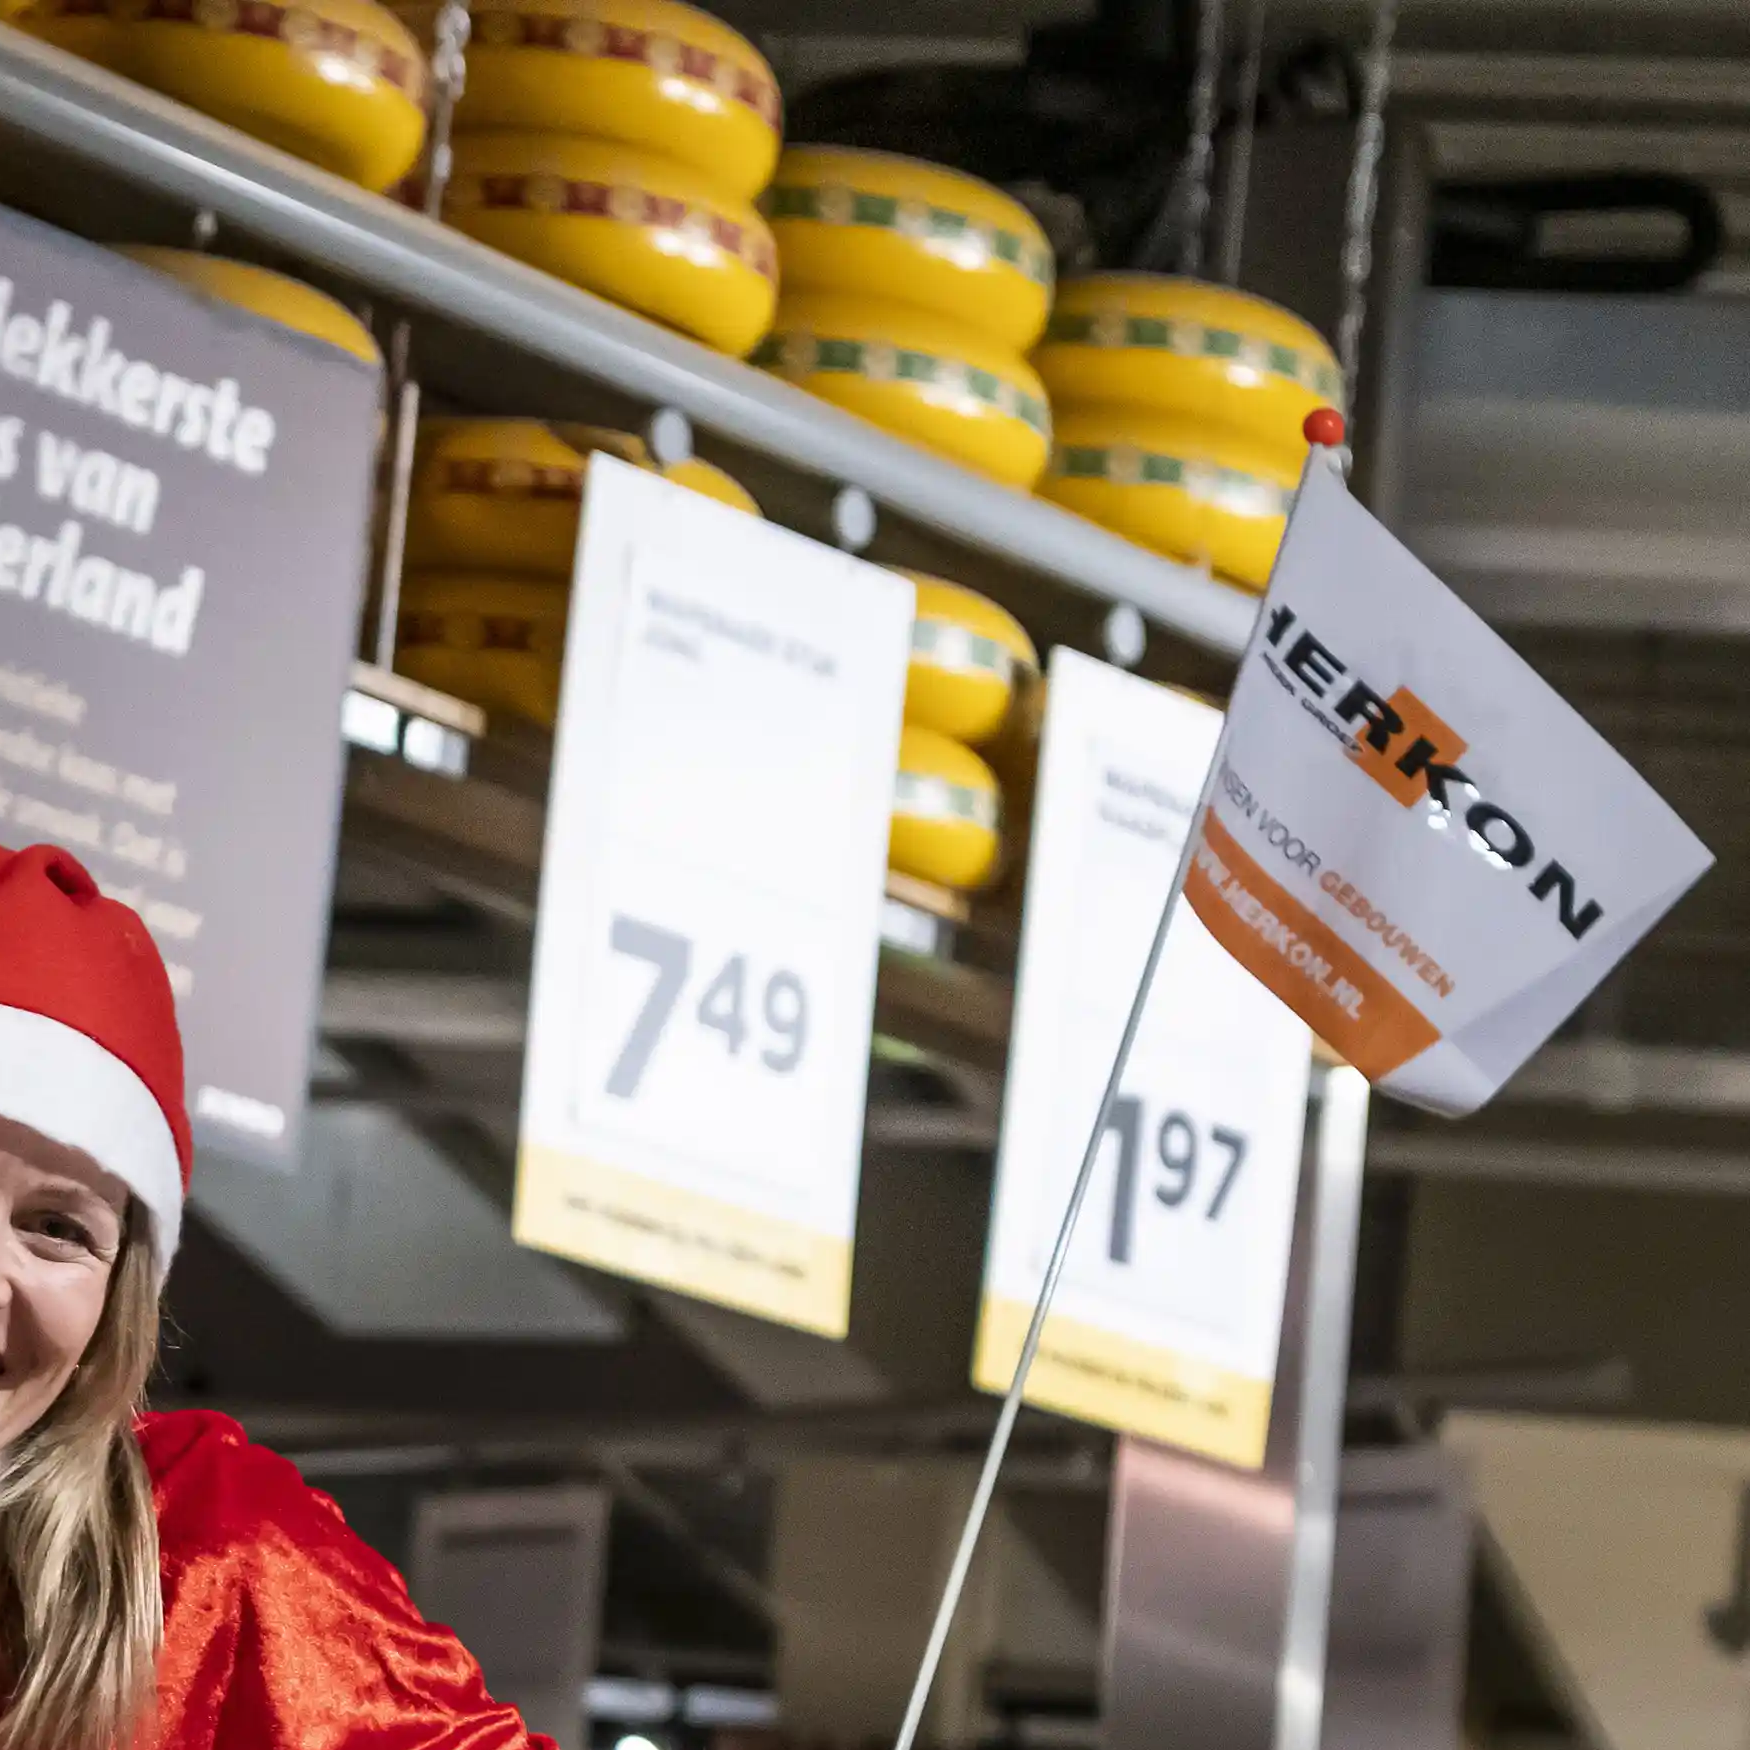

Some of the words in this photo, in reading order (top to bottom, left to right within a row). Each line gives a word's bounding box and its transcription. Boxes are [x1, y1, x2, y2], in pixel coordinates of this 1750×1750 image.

[36, 429, 160, 534] van
[1258, 810, 1321, 878] VOOR
[1320, 870, 1456, 999] GEBOUWEN
